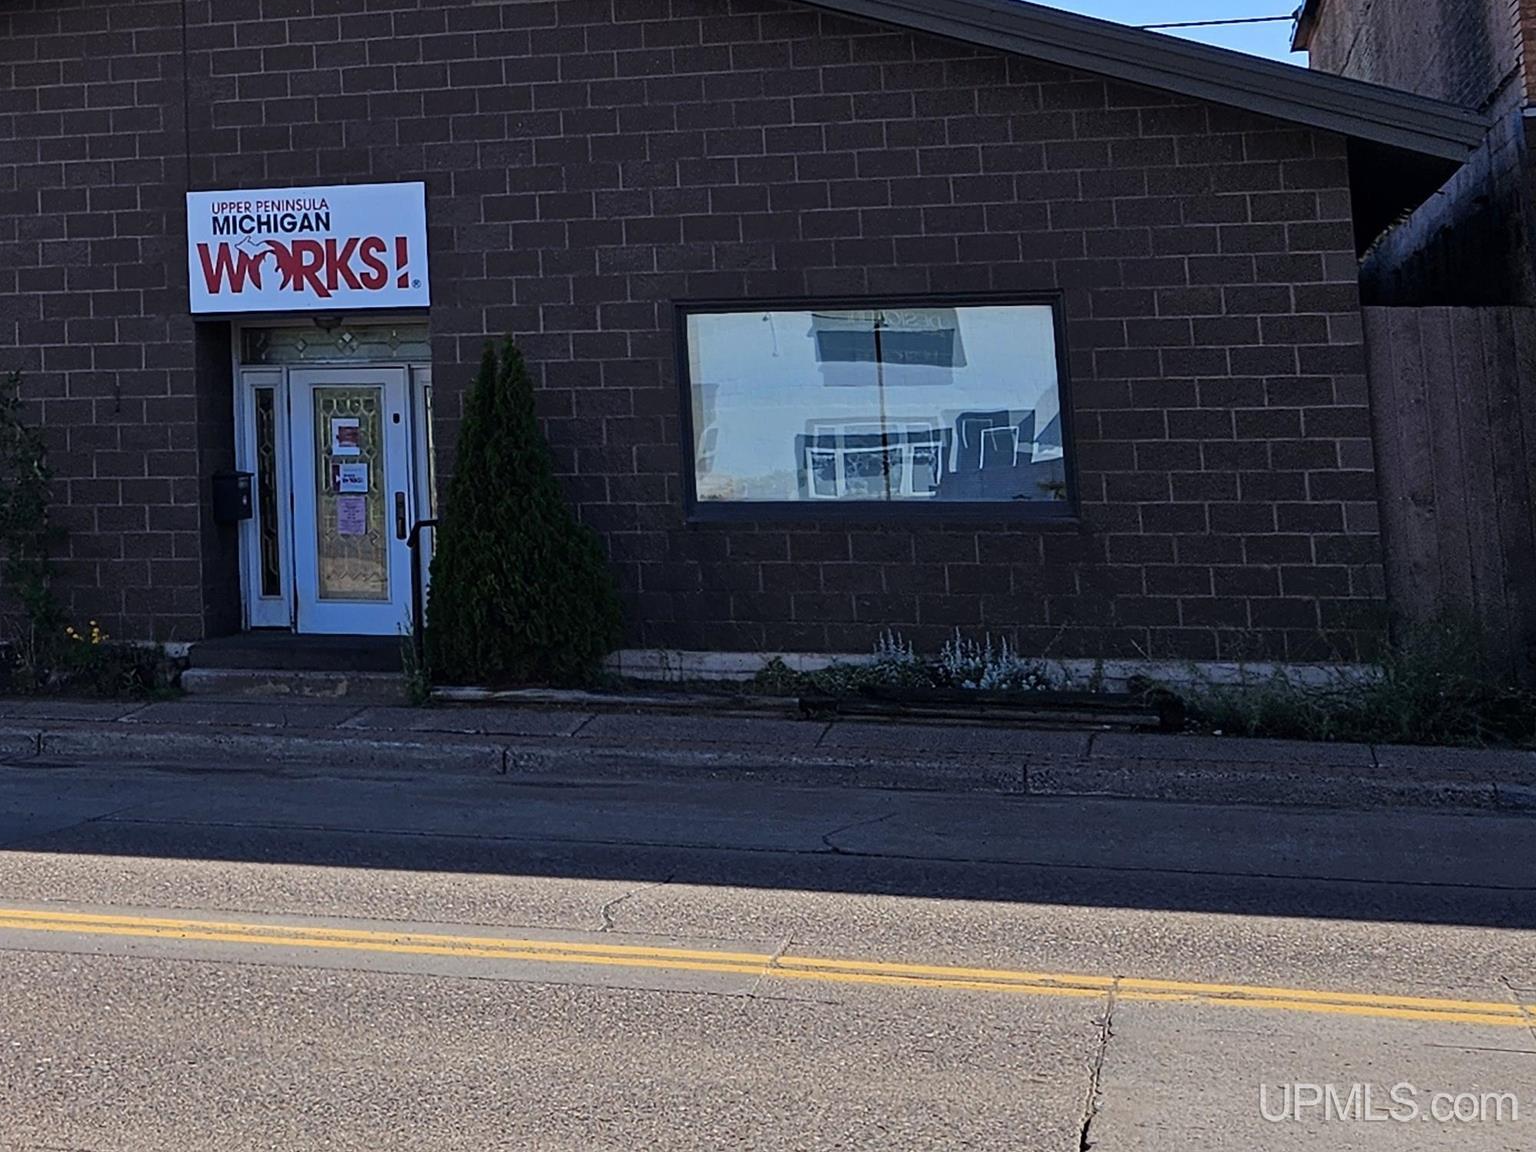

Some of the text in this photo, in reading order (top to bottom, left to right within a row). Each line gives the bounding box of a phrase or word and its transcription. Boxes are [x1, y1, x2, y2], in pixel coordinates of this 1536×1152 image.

[211, 198, 329, 215] UPPER PENINSULA
[212, 212, 331, 235] MICHIGAN
